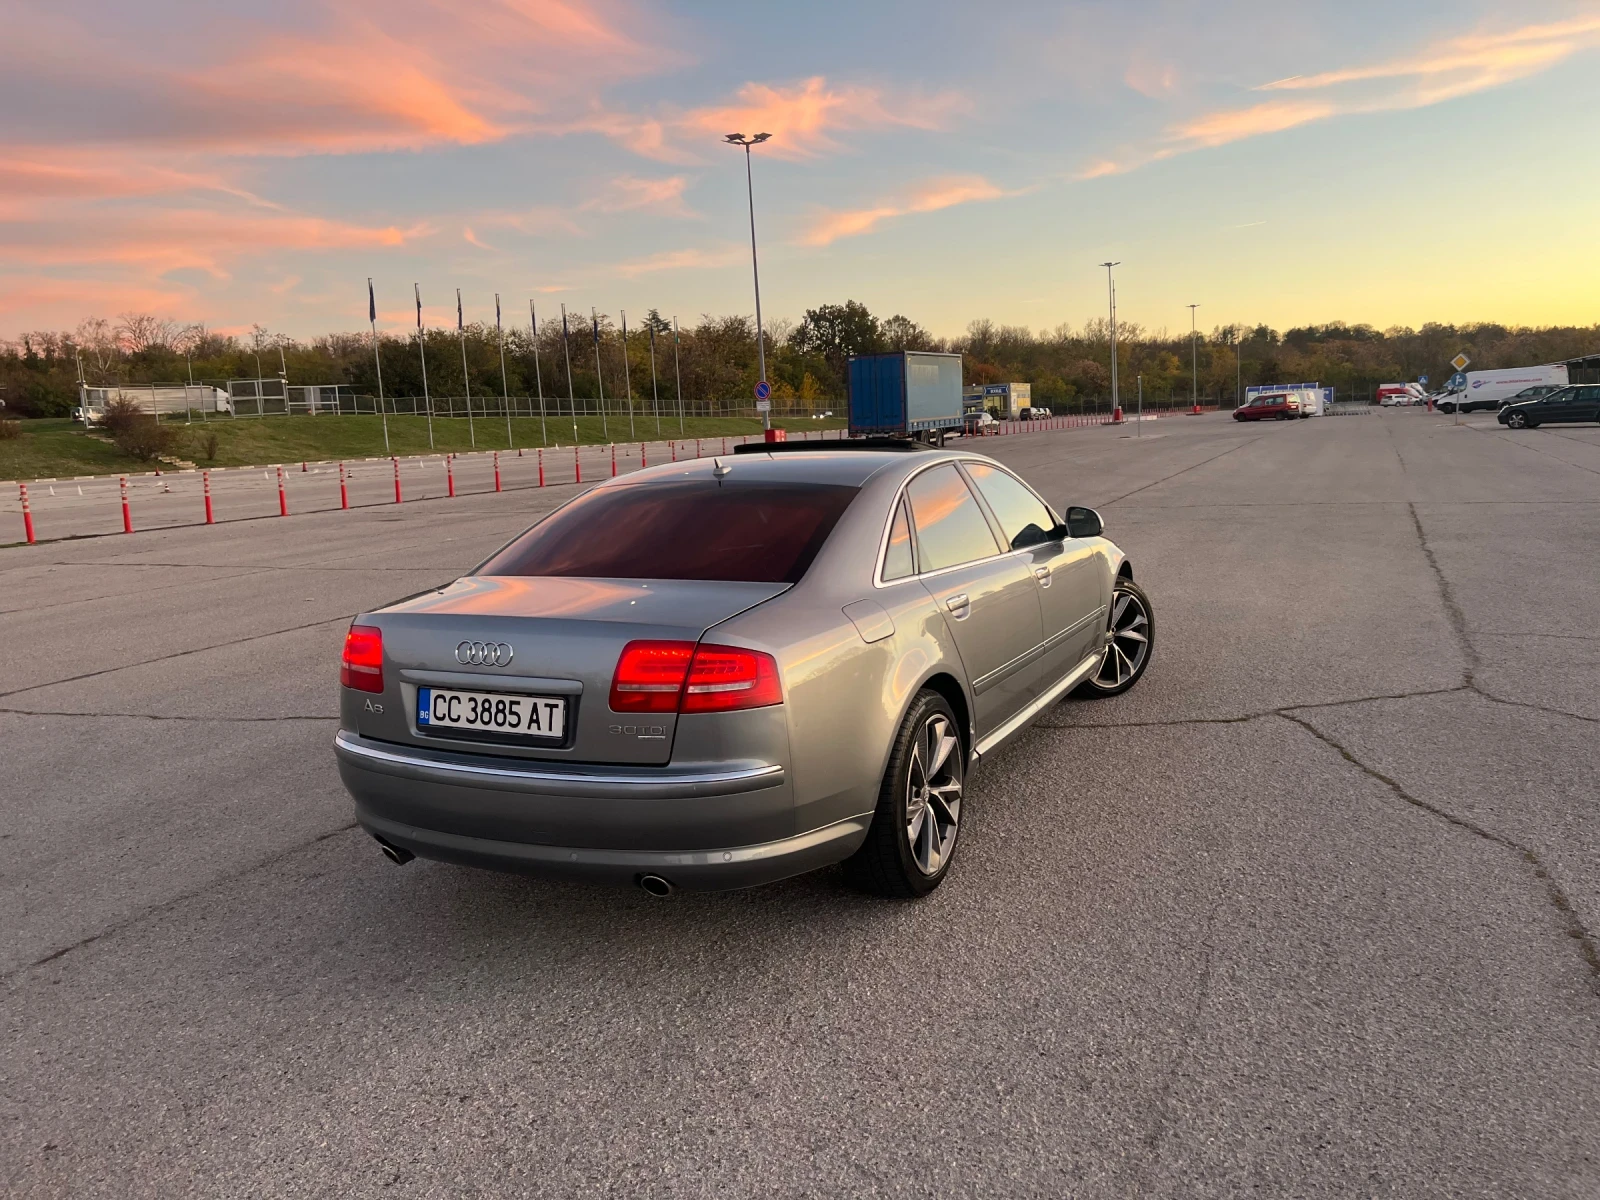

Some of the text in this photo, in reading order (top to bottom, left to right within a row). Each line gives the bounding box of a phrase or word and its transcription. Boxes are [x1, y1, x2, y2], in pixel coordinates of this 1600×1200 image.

[363, 698, 384, 714] A8
[433, 694, 559, 732] CC 3885 AT
[419, 710, 429, 719] BG
